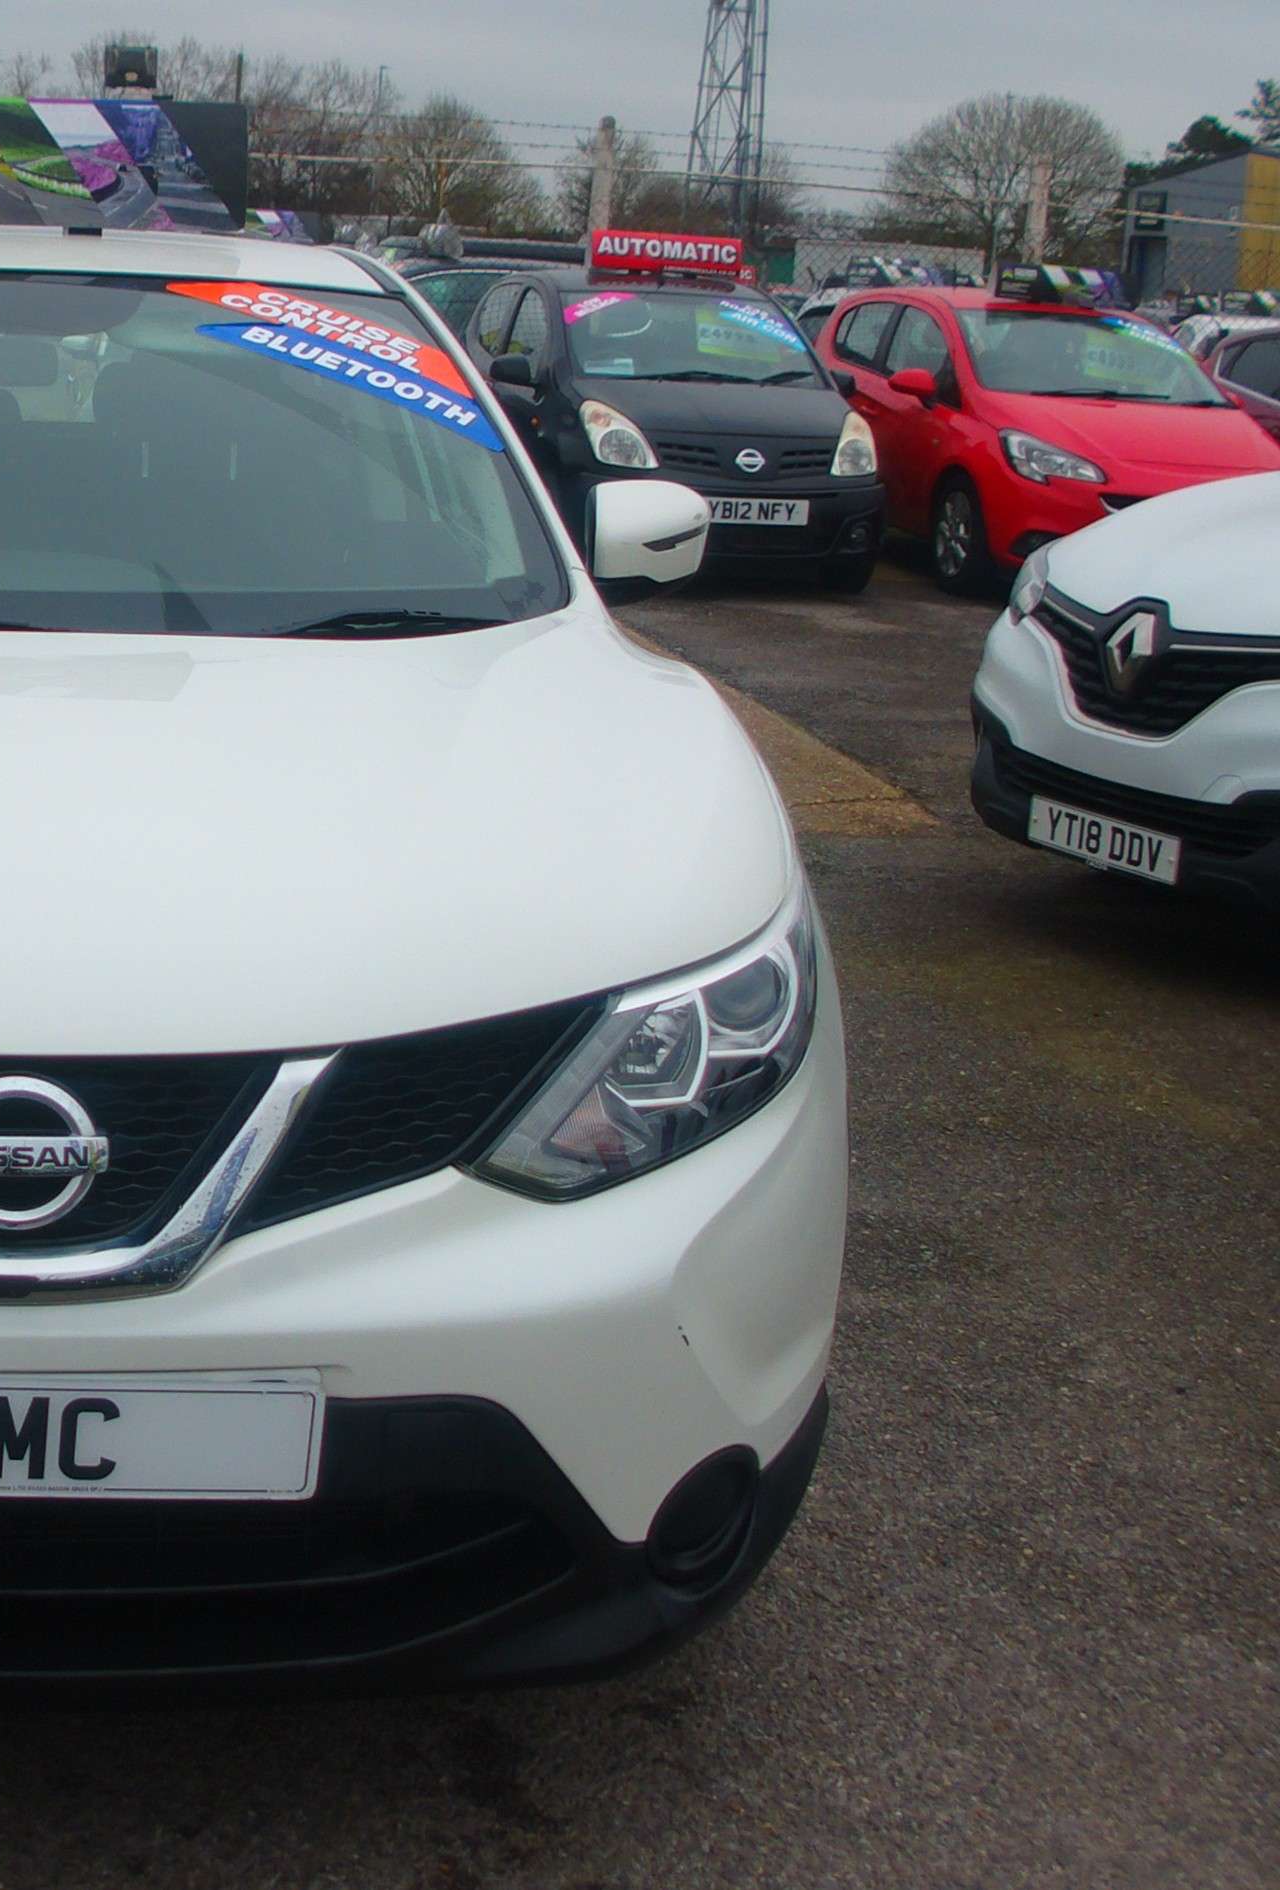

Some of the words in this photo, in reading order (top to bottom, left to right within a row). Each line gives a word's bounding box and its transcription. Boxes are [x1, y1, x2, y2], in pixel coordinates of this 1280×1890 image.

[597, 236, 737, 264] AUTOMATIC
[220, 294, 422, 373] CONTROL
[257, 292, 421, 355] CRUISE
[241, 326, 477, 427] BLUETOOTH
[709, 501, 752, 519] YB12
[757, 502, 796, 520] NFY
[1049, 807, 1102, 854] YT18
[1108, 826, 1162, 872] DDV
